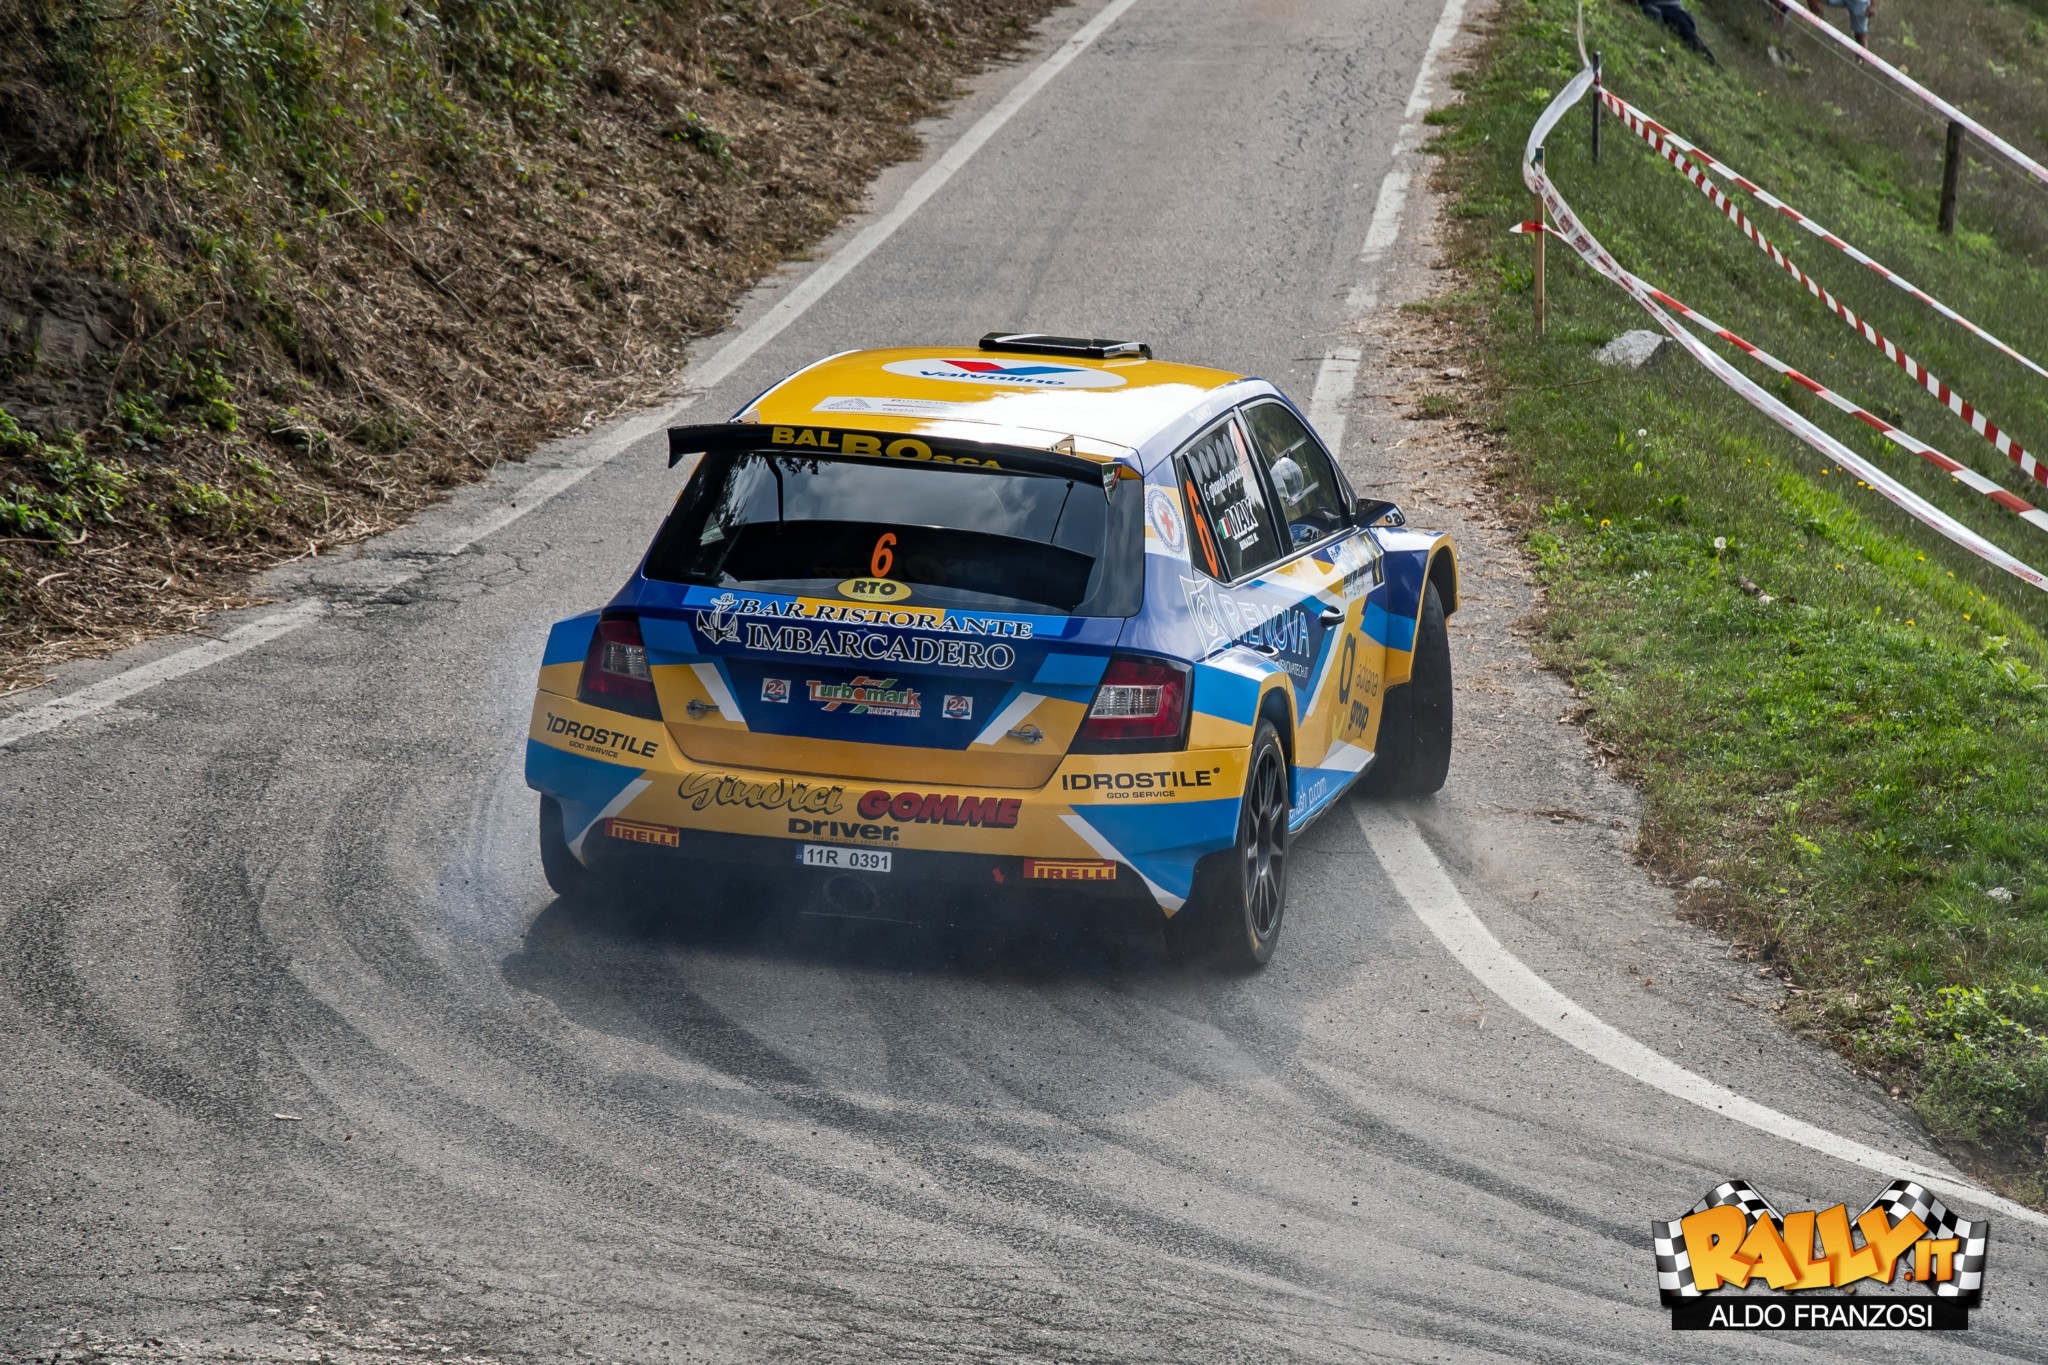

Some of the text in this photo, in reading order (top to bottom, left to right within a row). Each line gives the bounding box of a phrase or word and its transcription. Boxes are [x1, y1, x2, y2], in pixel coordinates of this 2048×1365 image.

[919, 370, 1066, 386] Valvoline
[1185, 480, 1219, 578] 6
[870, 532, 897, 578] 6
[852, 580, 897, 596] RTO
[736, 597, 1034, 640] BAR RISTORANTE
[1218, 592, 1311, 659] RENOVA
[746, 622, 1016, 671] IMBARCADERO
[767, 682, 786, 695] 24
[806, 680, 922, 709] Turbomark
[949, 699, 968, 711] 24
[569, 740, 619, 759] GDO SERVICE
[678, 772, 1024, 829] Giudici GOMME
[1132, 790, 1176, 799] SERVICE
[807, 848, 888, 870] 11R 0391
[1023, 858, 1117, 880] PIRELLI
